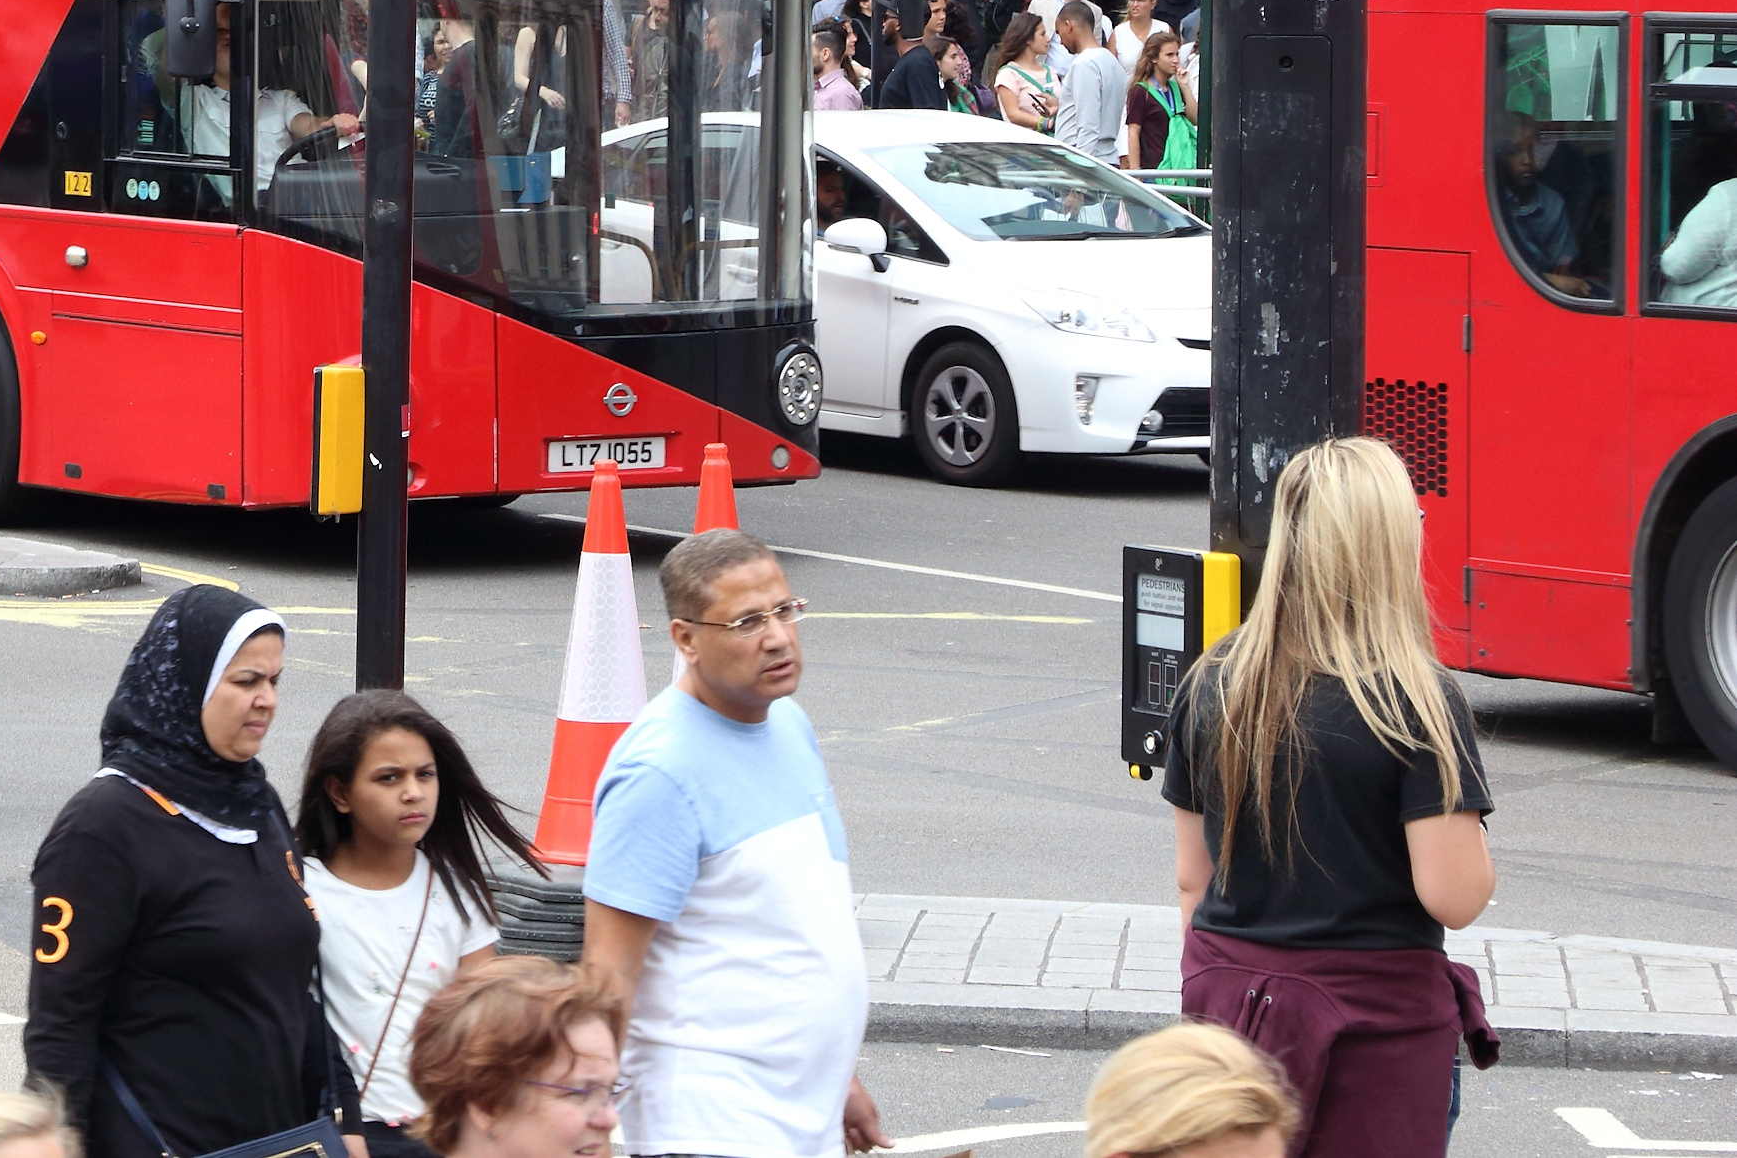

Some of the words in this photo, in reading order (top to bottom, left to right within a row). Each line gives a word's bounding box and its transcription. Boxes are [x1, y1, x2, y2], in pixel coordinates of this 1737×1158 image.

[67, 174, 90, 193] 122
[1141, 578, 1185, 593] PEDESTRIANS
[35, 896, 74, 963] 3
